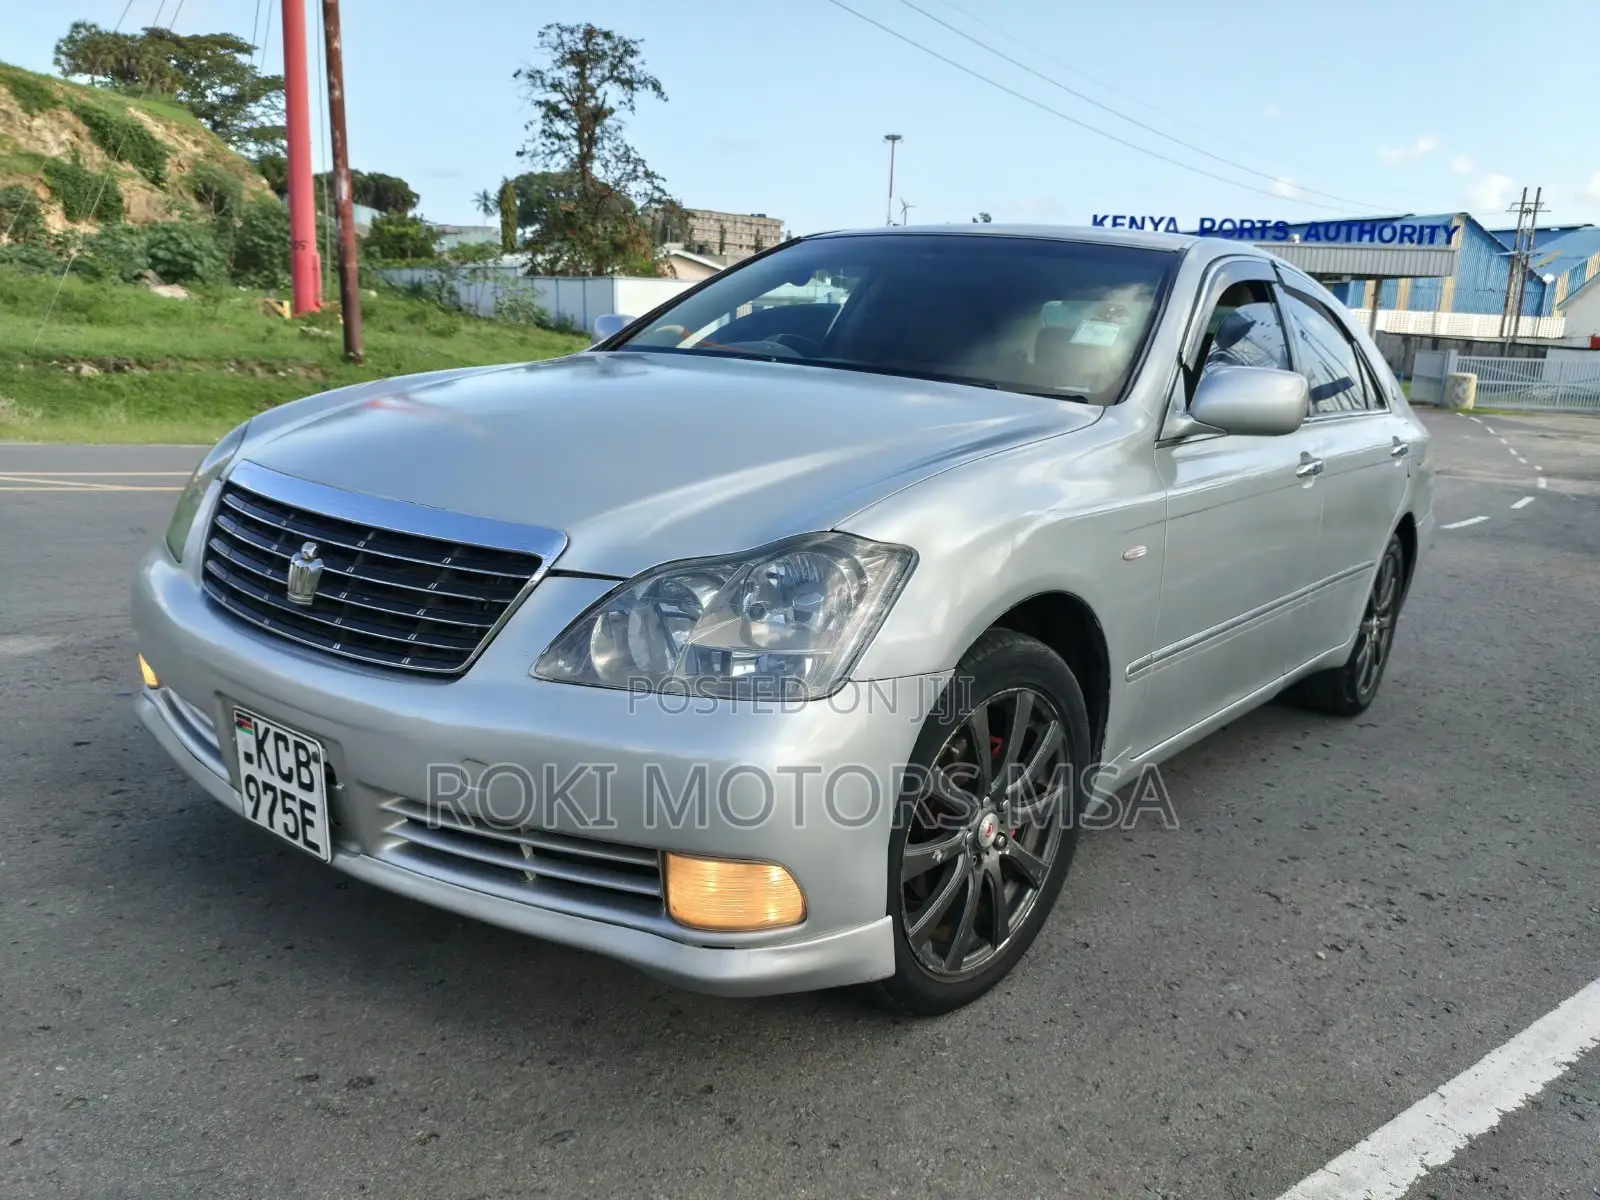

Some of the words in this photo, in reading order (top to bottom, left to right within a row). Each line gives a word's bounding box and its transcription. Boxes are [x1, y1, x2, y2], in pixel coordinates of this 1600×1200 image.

[1092, 214, 1179, 234] KENYA
[1199, 217, 1290, 241] PORTS
[1303, 221, 1460, 246] AUTHORITY
[254, 721, 315, 793] KCB
[244, 773, 321, 854] 975E
